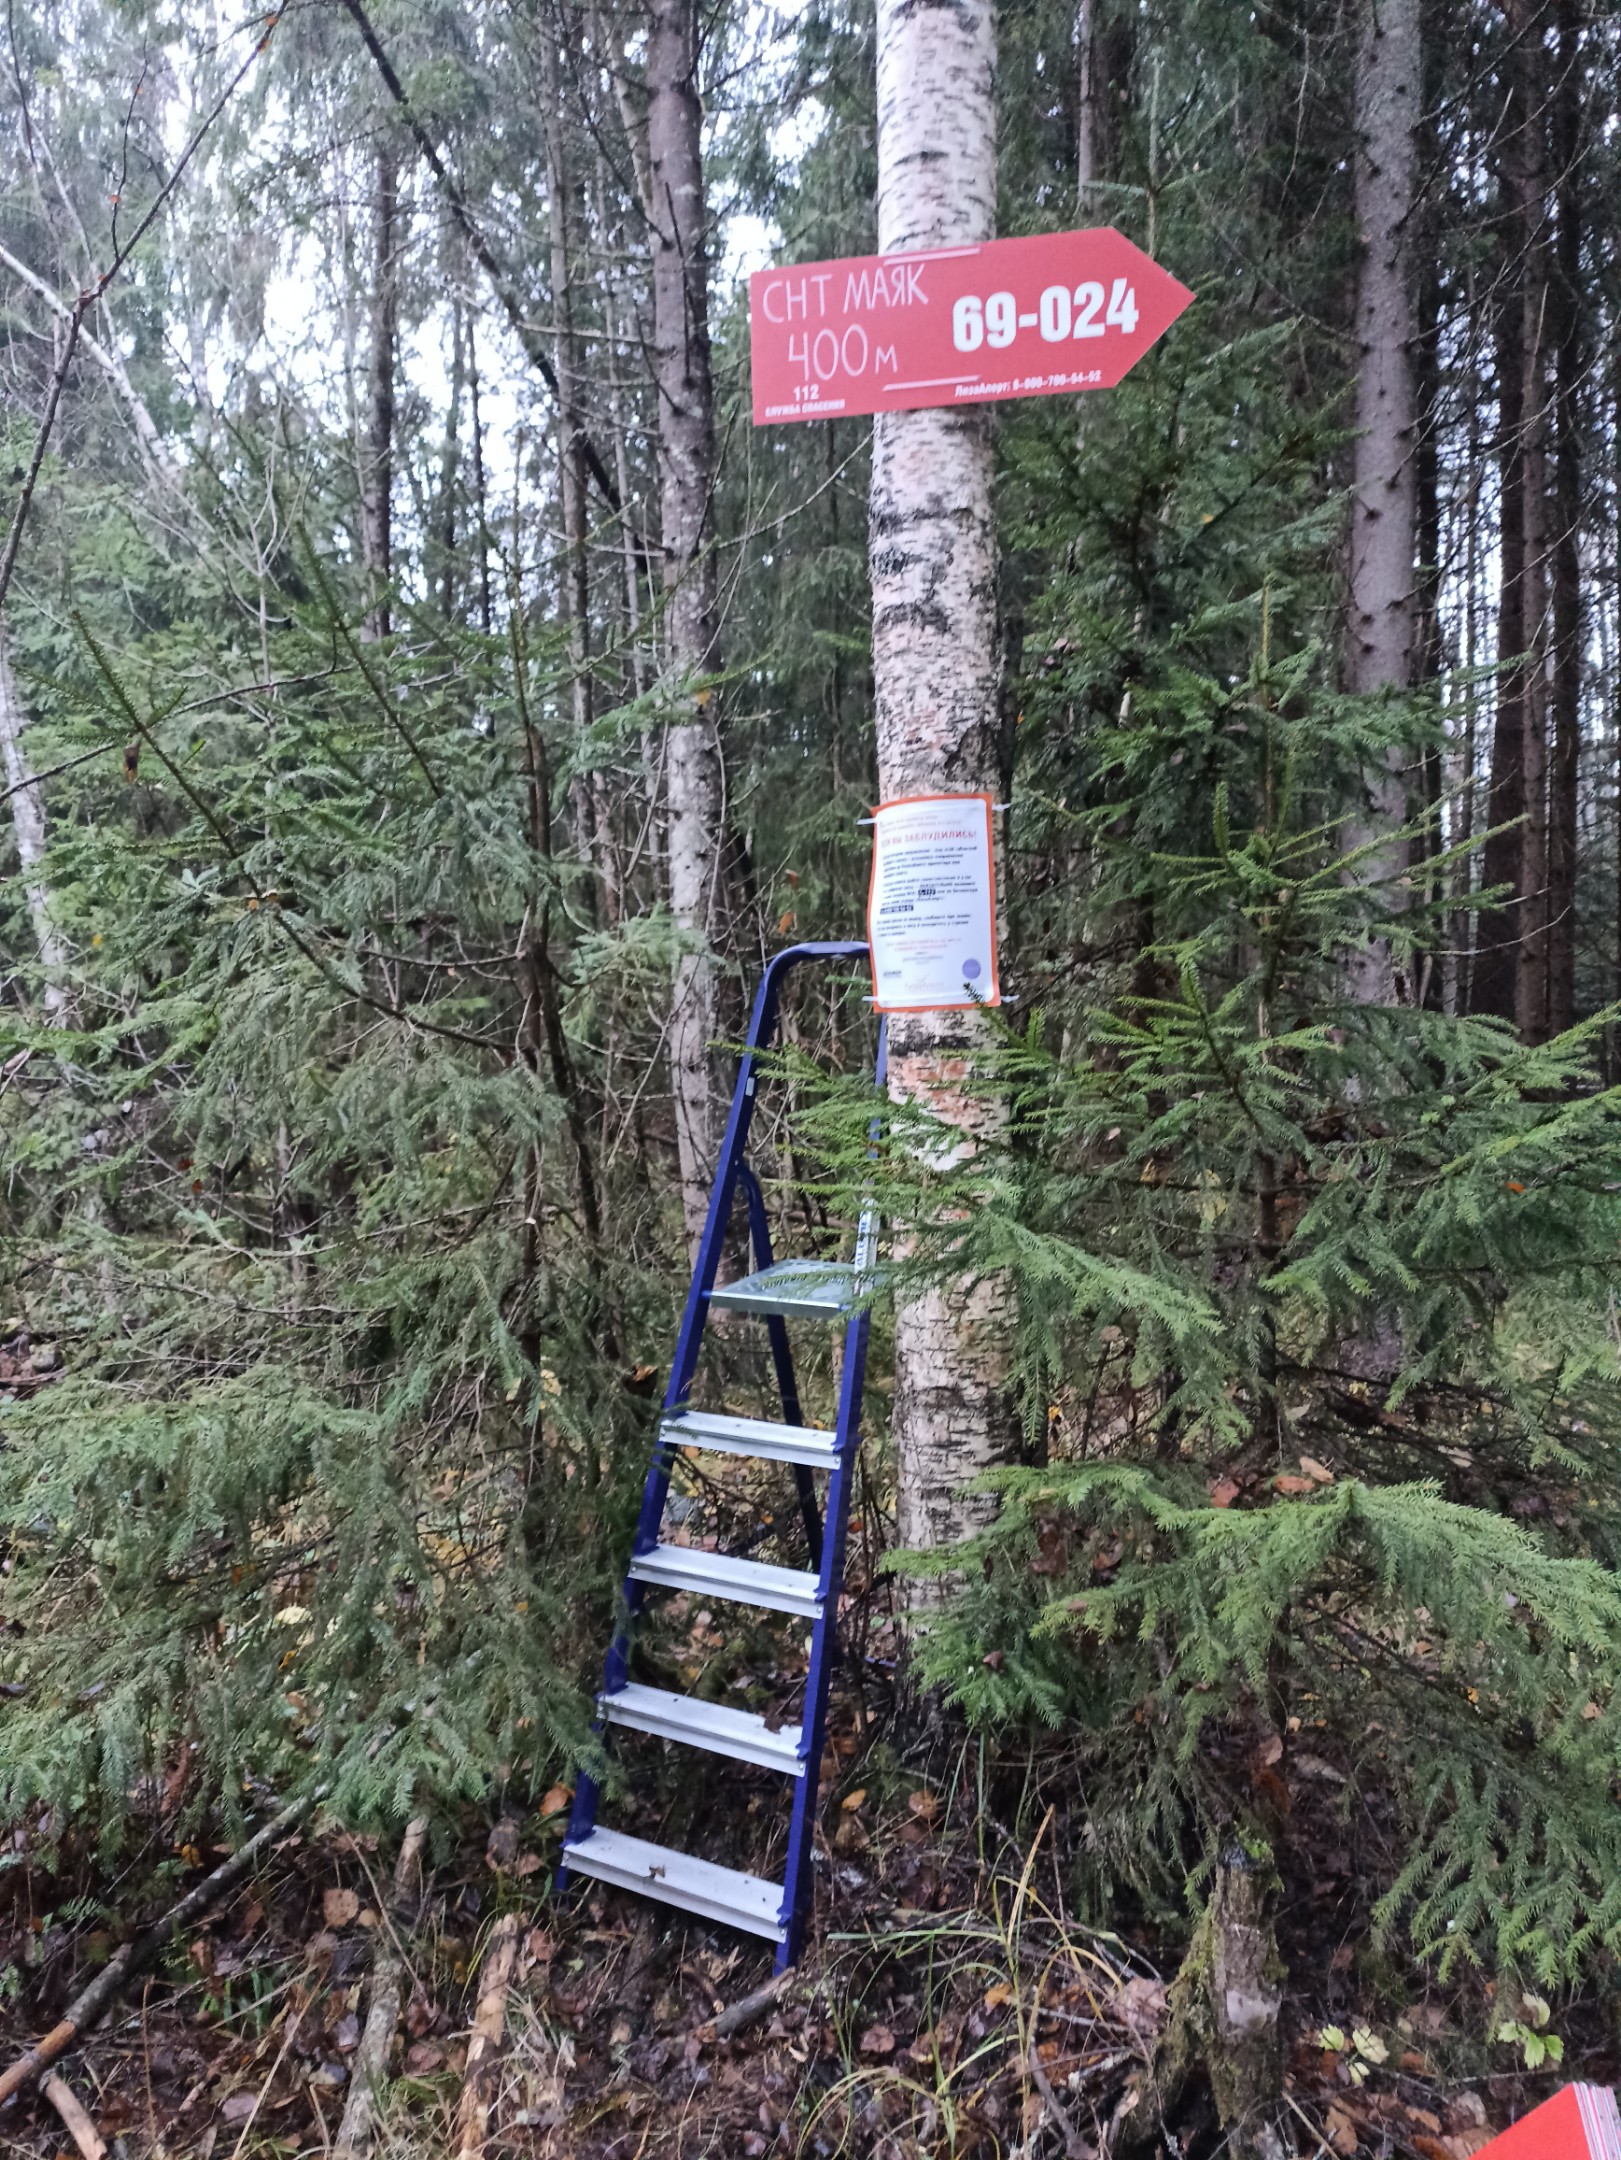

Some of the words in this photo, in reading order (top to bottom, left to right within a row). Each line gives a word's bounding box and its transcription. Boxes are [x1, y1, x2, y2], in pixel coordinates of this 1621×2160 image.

[763, 274, 832, 323] СНТ
[843, 263, 929, 314] МАЯК
[952, 277, 1139, 353] 69-024
[788, 323, 868, 382] 400
[793, 383, 820, 401] 112
